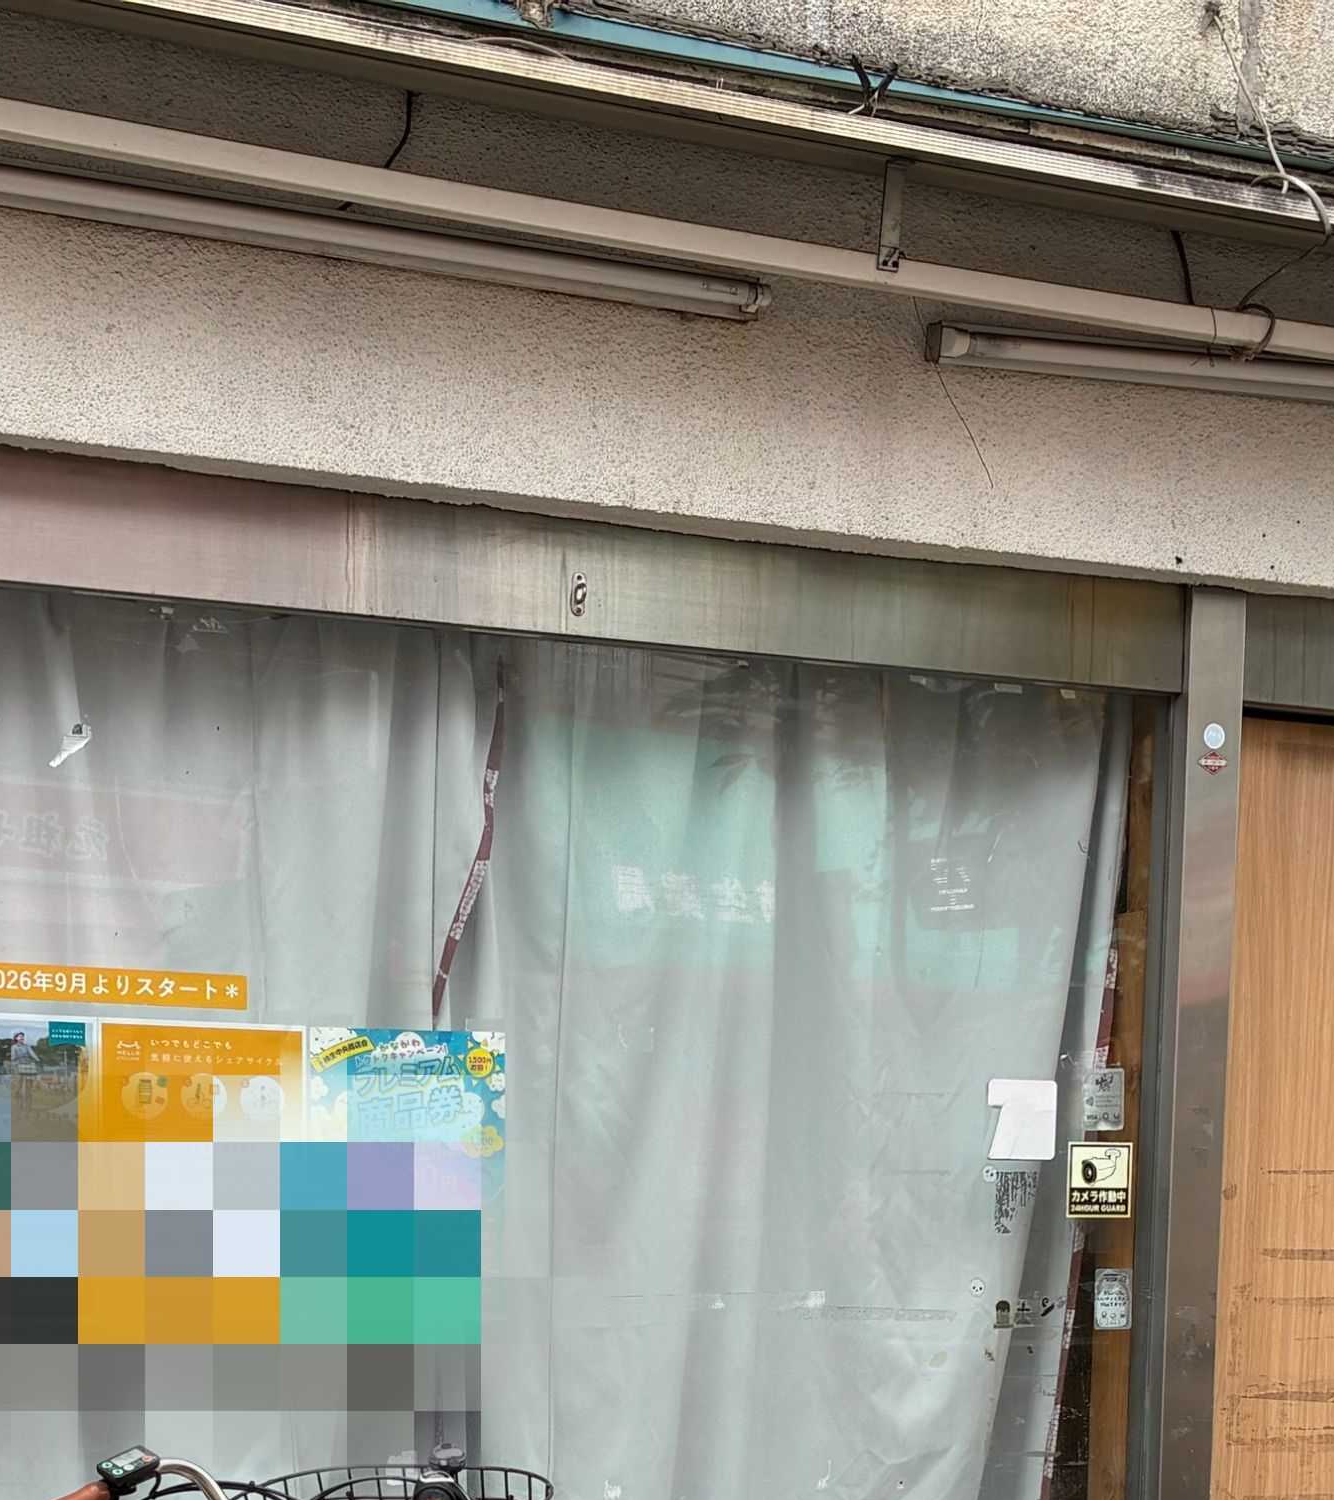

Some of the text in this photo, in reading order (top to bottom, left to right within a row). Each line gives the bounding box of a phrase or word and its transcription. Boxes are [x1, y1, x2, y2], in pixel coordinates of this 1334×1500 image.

[150, 1039, 233, 1050] いつでもどこでも
[1071, 1189, 1127, 1203] カメラ作動中
